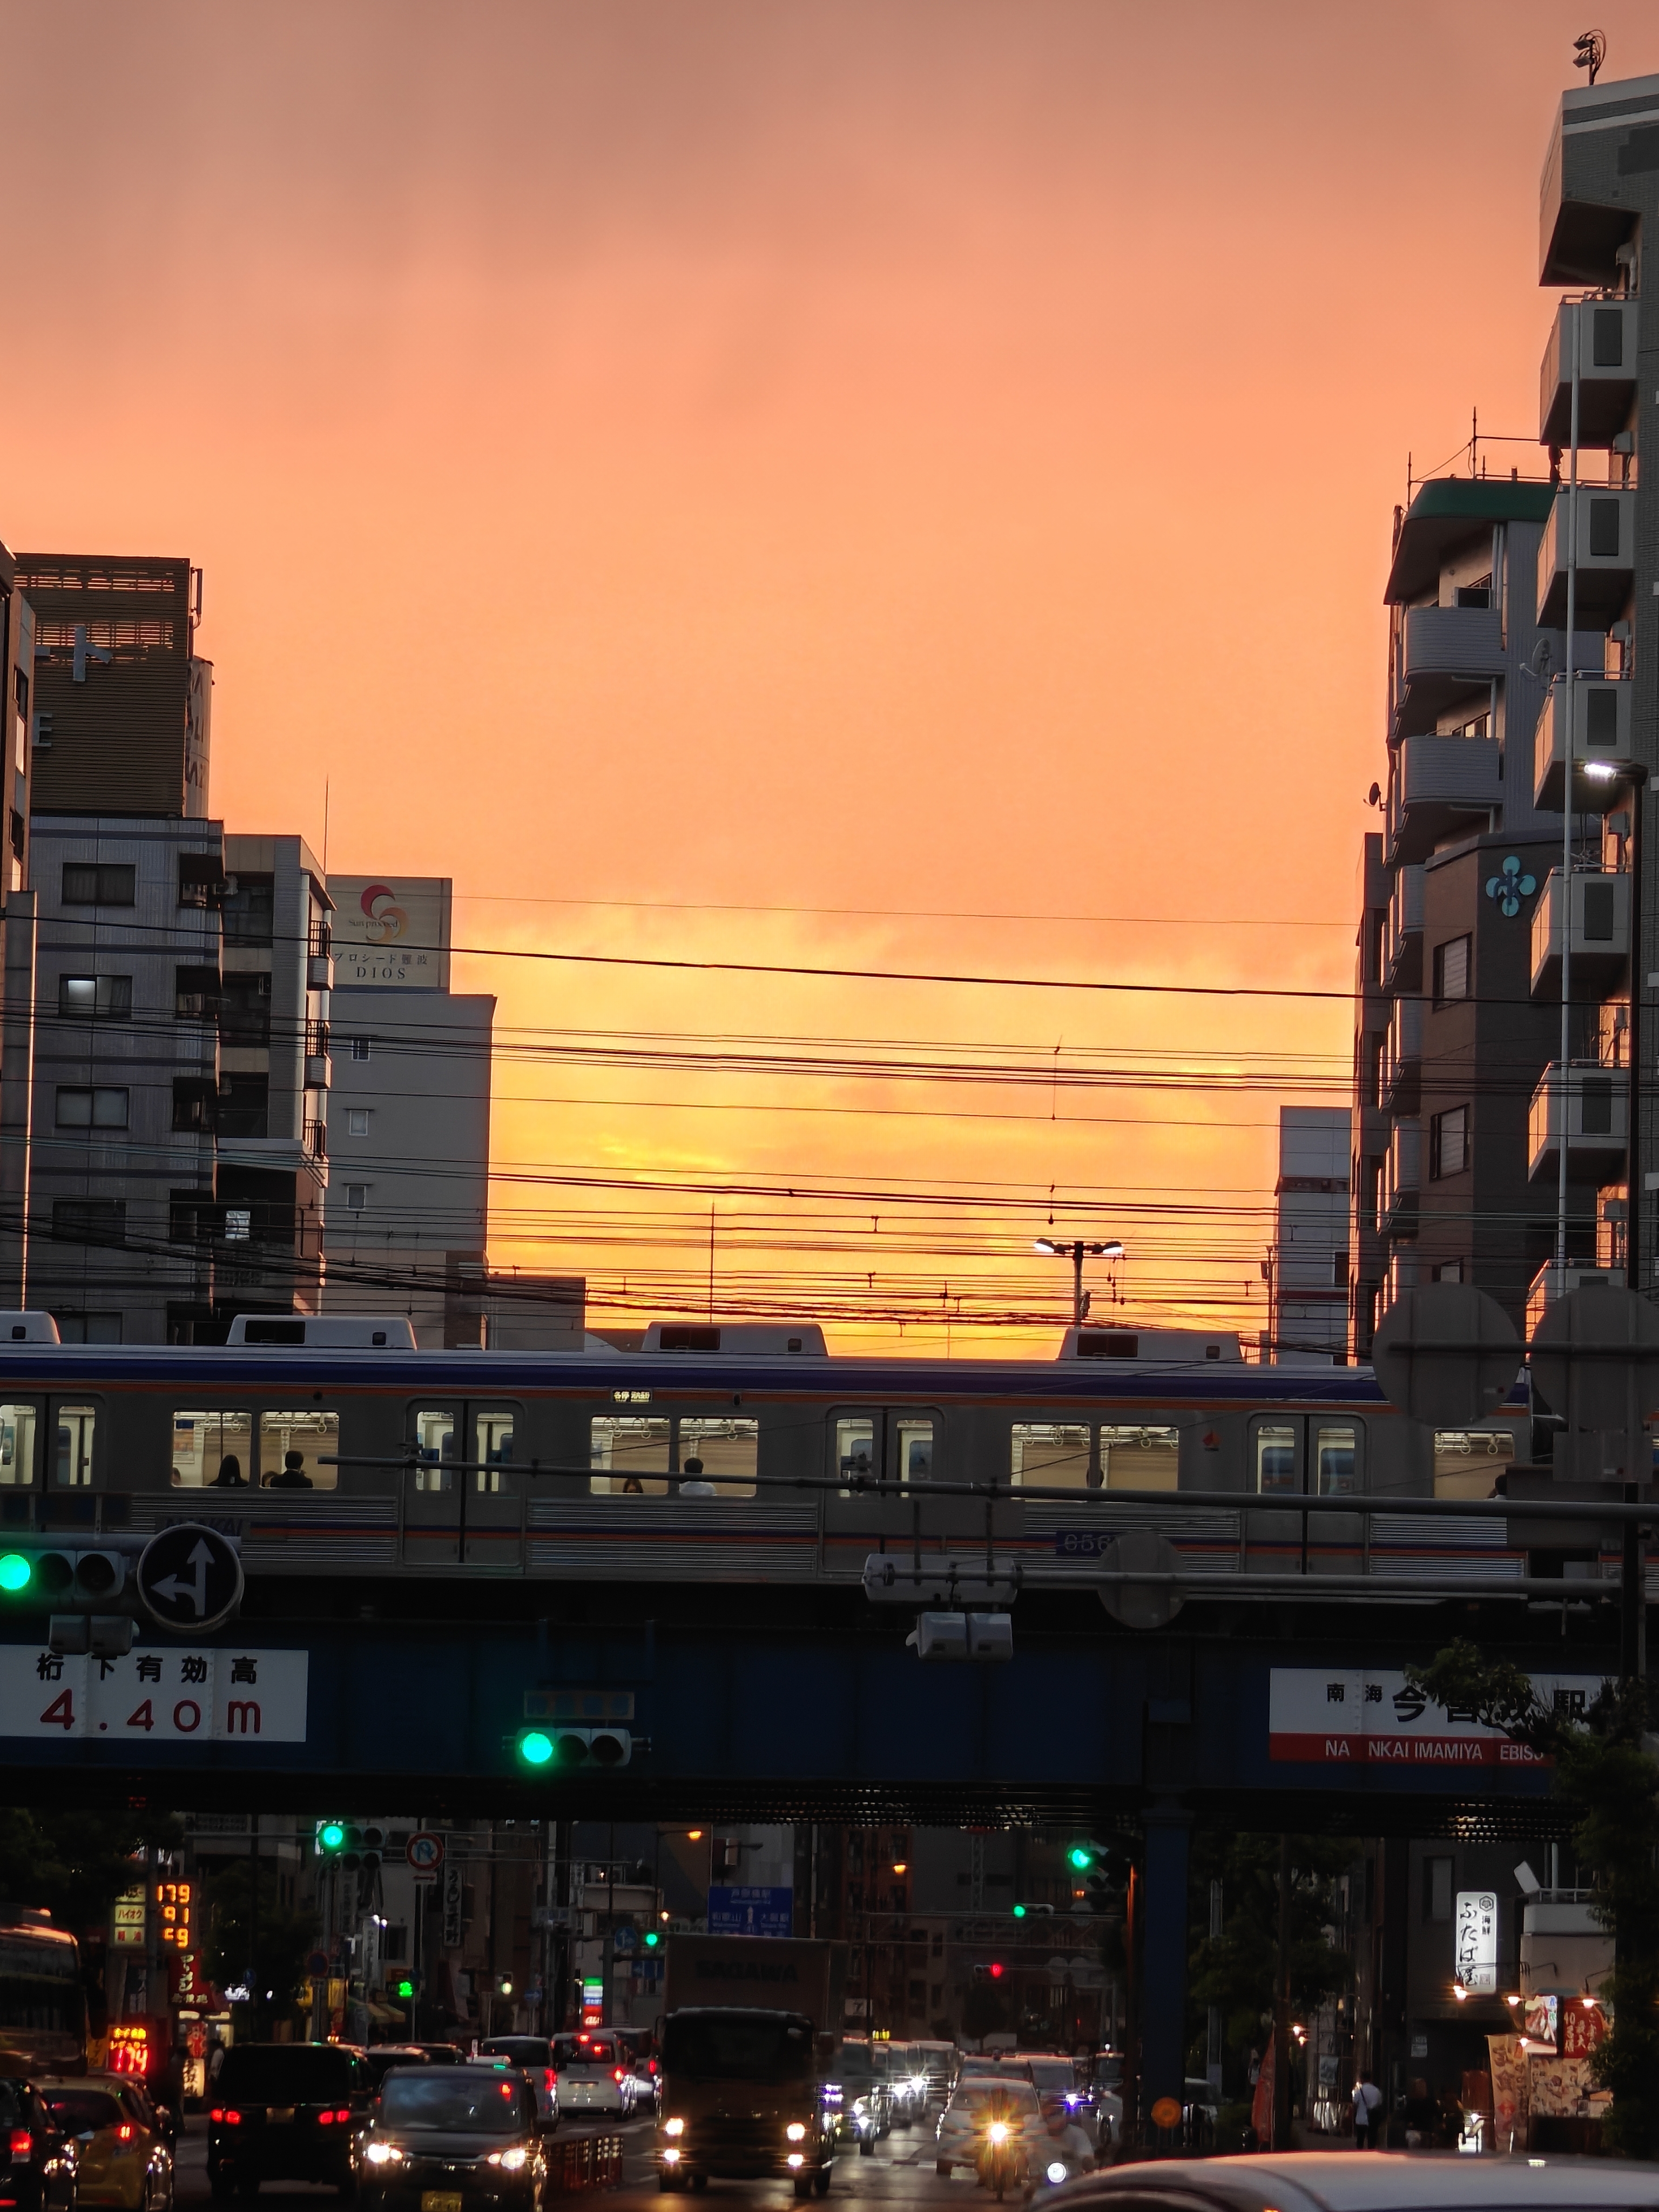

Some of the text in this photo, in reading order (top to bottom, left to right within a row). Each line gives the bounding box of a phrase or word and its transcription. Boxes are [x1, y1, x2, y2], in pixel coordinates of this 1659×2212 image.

[356, 967, 405, 980] DIOS
[36, 1653, 258, 1684] 桁下有効高
[1414, 1742, 1483, 1760] IMAMIYA
[118, 1909, 142, 1919] ハイオク
